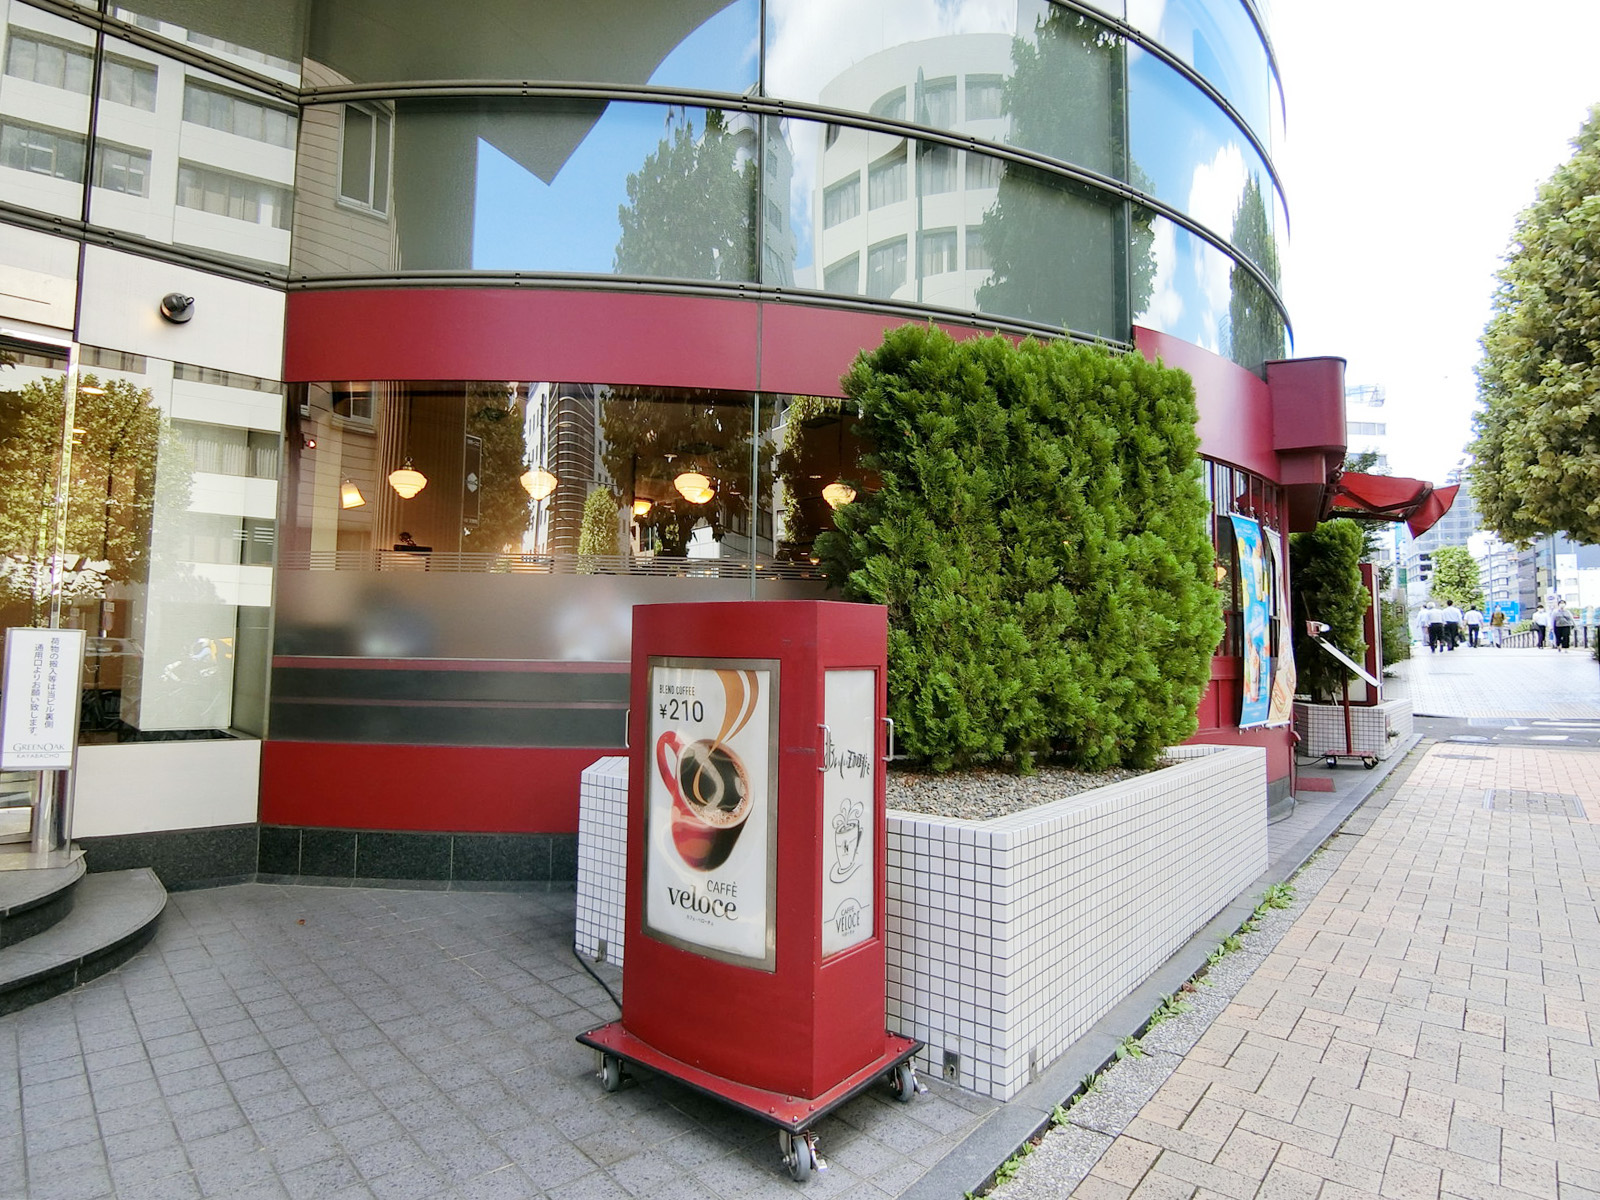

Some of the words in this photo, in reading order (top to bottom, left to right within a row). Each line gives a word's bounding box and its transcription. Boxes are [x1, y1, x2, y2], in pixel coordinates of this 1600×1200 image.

[659, 684, 674, 695] BLEND
[676, 685, 695, 696] COFFEE
[659, 698, 704, 723] ¥210
[667, 884, 739, 921] veloce
[835, 910, 860, 934] VELOCE
